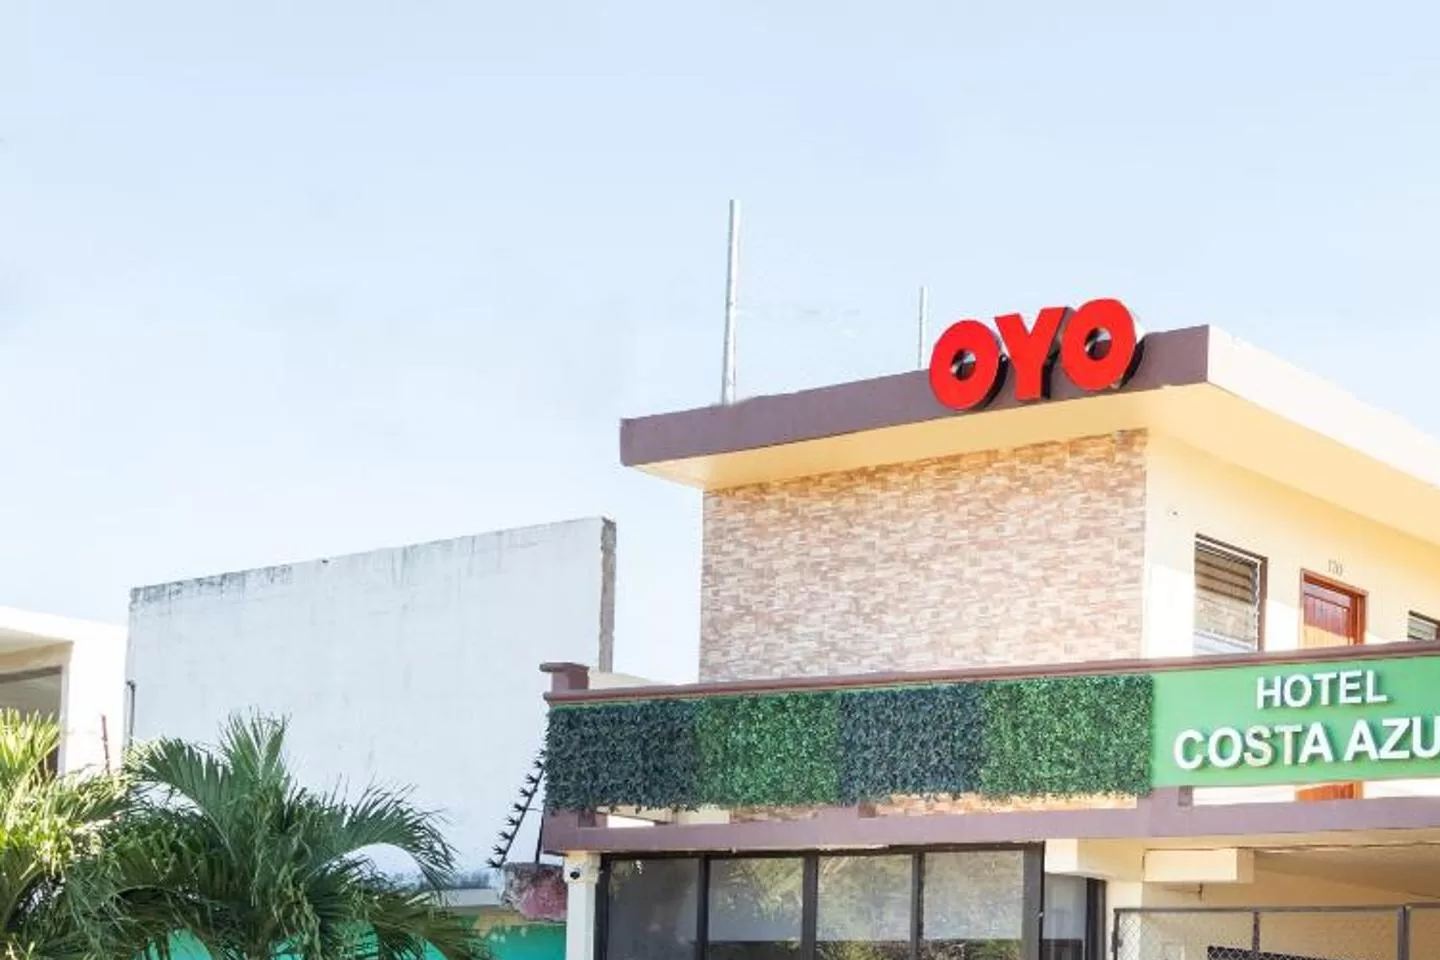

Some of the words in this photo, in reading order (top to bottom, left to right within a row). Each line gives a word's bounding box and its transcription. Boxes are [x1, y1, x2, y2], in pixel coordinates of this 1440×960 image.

[929, 297, 1140, 411] OYO
[1256, 669, 1389, 709] HOTEL
[1173, 722, 1335, 770] COSTA
